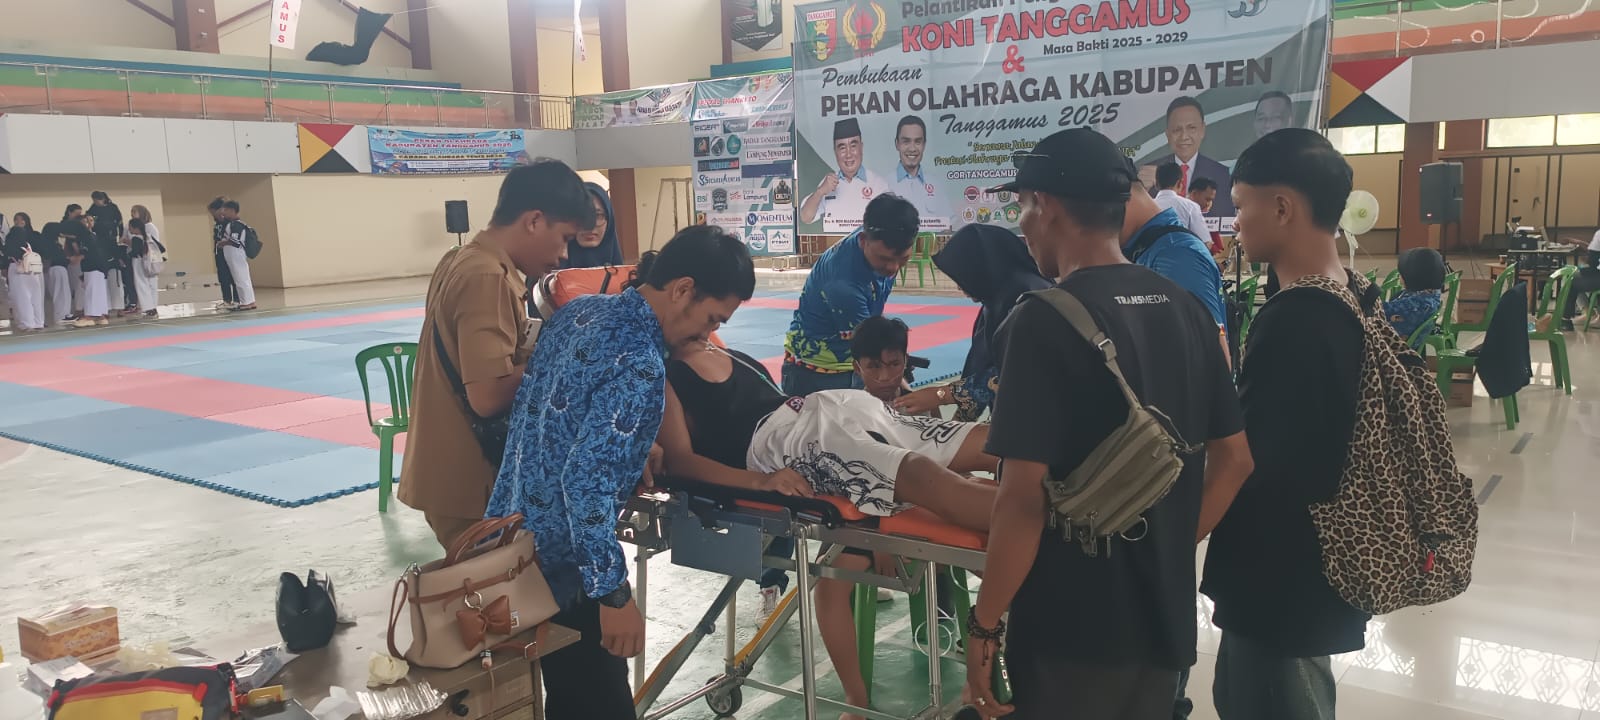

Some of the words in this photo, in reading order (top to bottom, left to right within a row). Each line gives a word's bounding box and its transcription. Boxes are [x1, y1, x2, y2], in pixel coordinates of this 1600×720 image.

[902, 18, 974, 52] KONI
[981, 0, 1191, 44] TANGGAMUS
[1043, 42, 1073, 55] Masa
[1076, 39, 1109, 53] Bakti
[1113, 36, 1142, 49] 2025
[1155, 31, 1188, 45] 2029
[1002, 44, 1025, 75] &
[821, 88, 901, 117] PEKAN
[907, 75, 1062, 112] OLAHRAGA
[1070, 57, 1273, 99] KABUPATEN
[822, 64, 923, 89] Pembukaan
[939, 114, 1049, 139] Tanggamus
[1058, 102, 1121, 127] 2025
[947, 171, 966, 180] GOR
[966, 169, 1018, 180] TANGGAMUS
[747, 212, 793, 226] MOMENTUM
[1114, 294, 1171, 305] TRANSMEDIA
